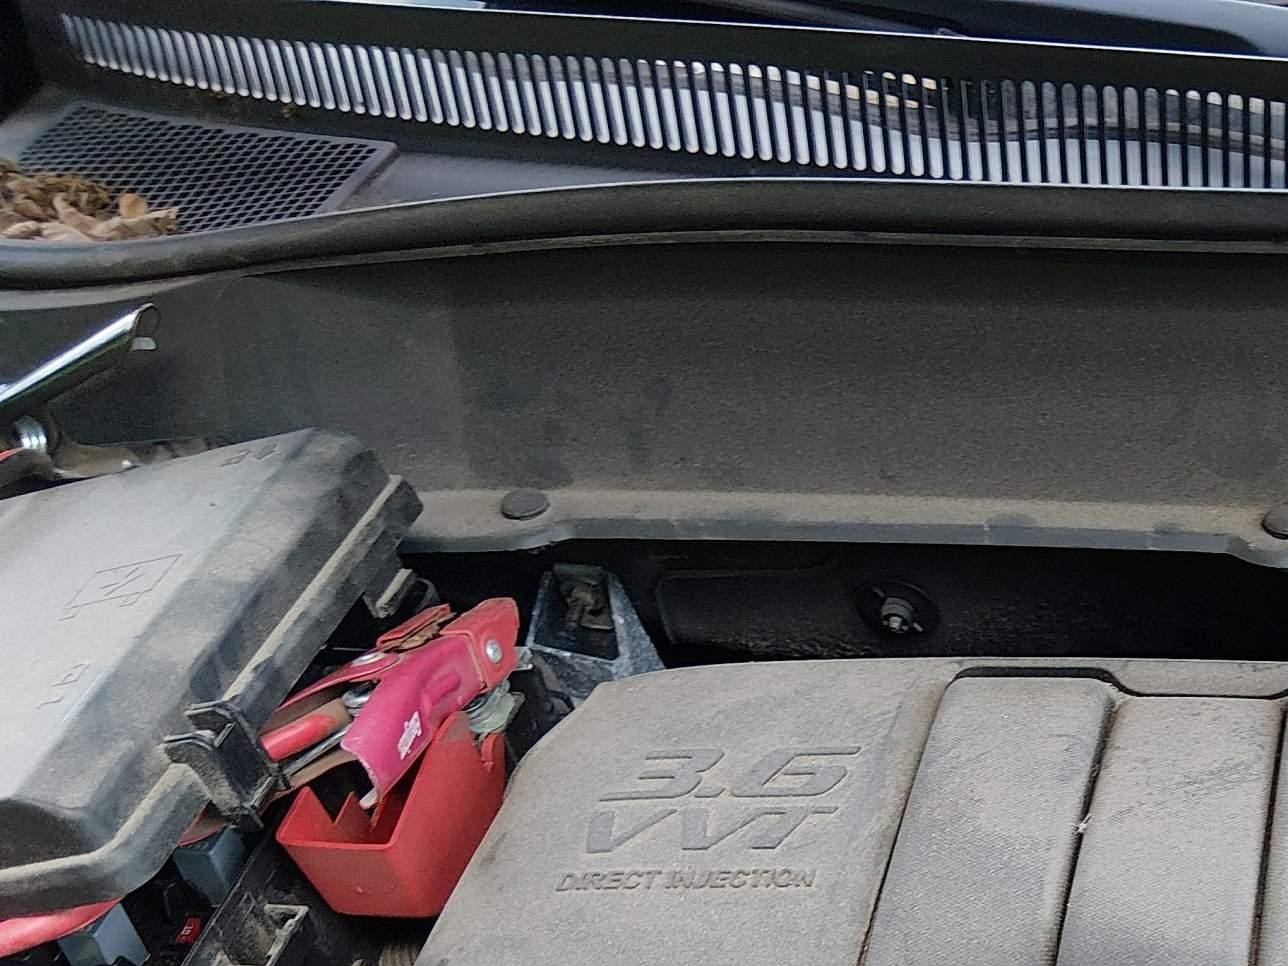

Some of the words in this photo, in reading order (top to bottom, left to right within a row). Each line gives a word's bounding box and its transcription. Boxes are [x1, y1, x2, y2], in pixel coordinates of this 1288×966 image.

[600, 746, 861, 802] 3.6
[586, 805, 839, 854] VVT
[556, 869, 662, 893] DIRECT
[663, 867, 817, 890] INJECTION
